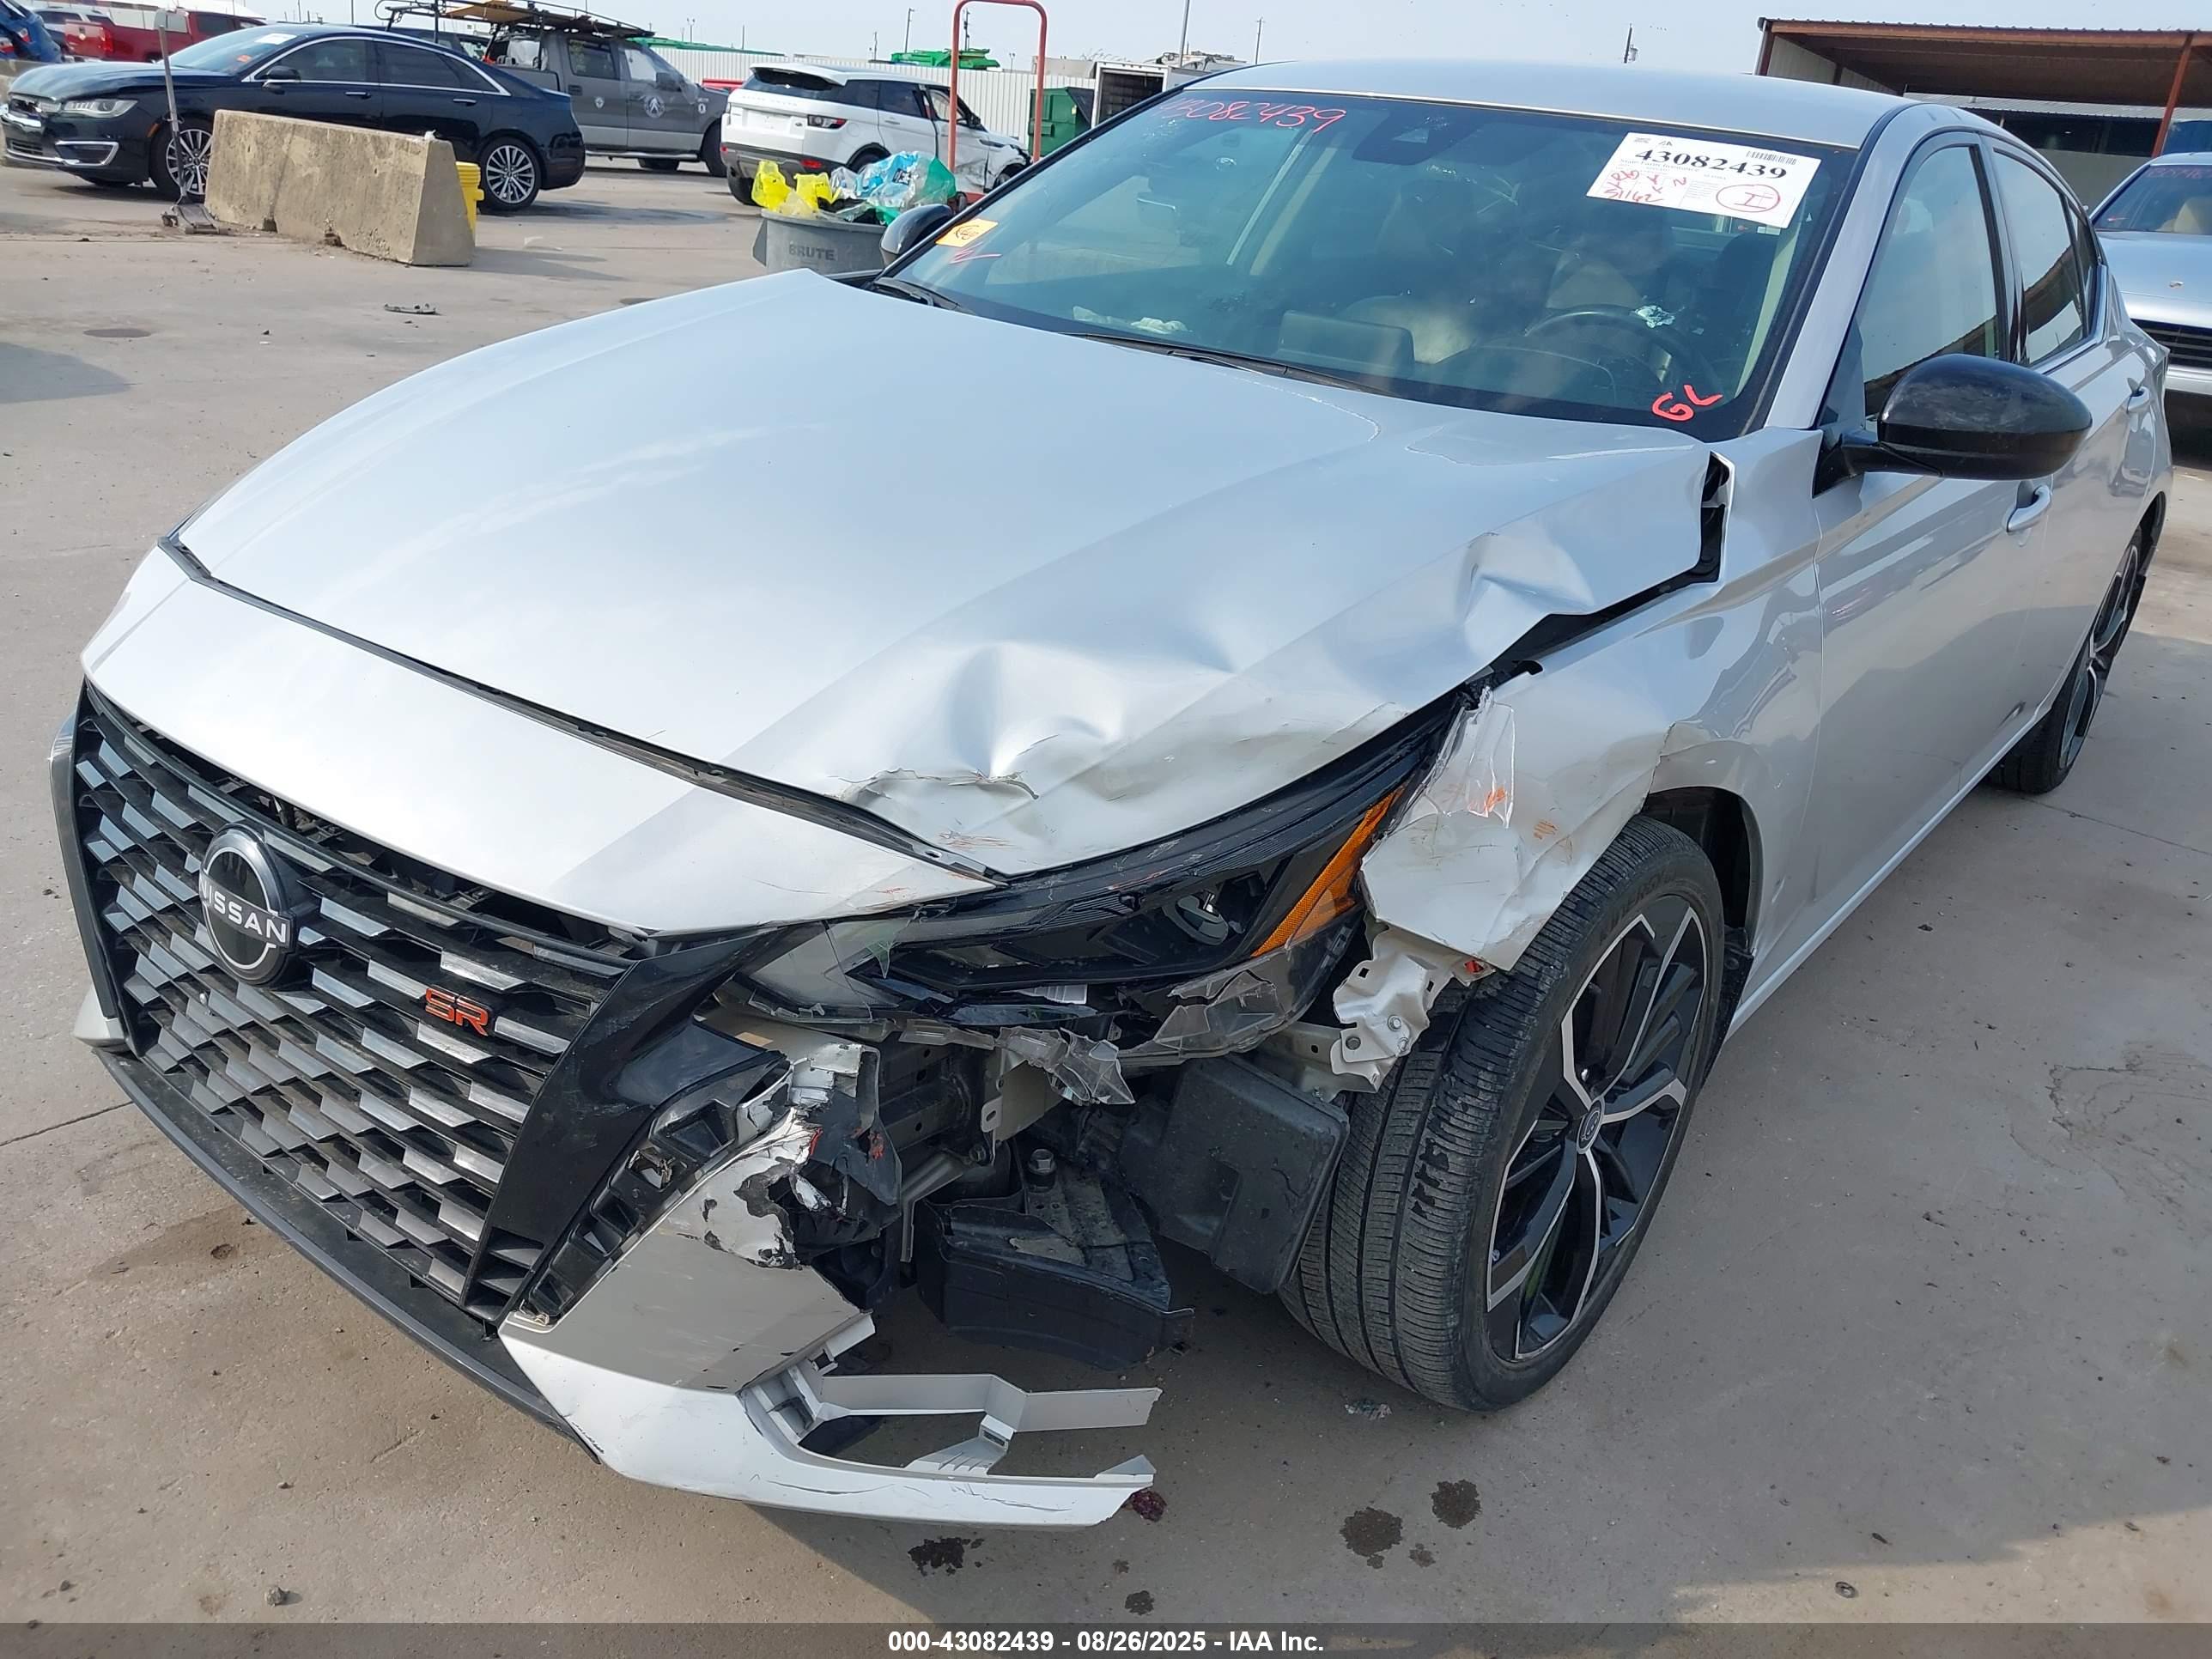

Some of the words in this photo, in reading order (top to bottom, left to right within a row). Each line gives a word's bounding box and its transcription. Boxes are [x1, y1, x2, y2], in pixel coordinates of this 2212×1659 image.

[1634, 149, 1787, 179] 43082439
[788, 244, 836, 261] BRUTE
[198, 875, 288, 944] NISSAN
[424, 986, 490, 1036] SR
